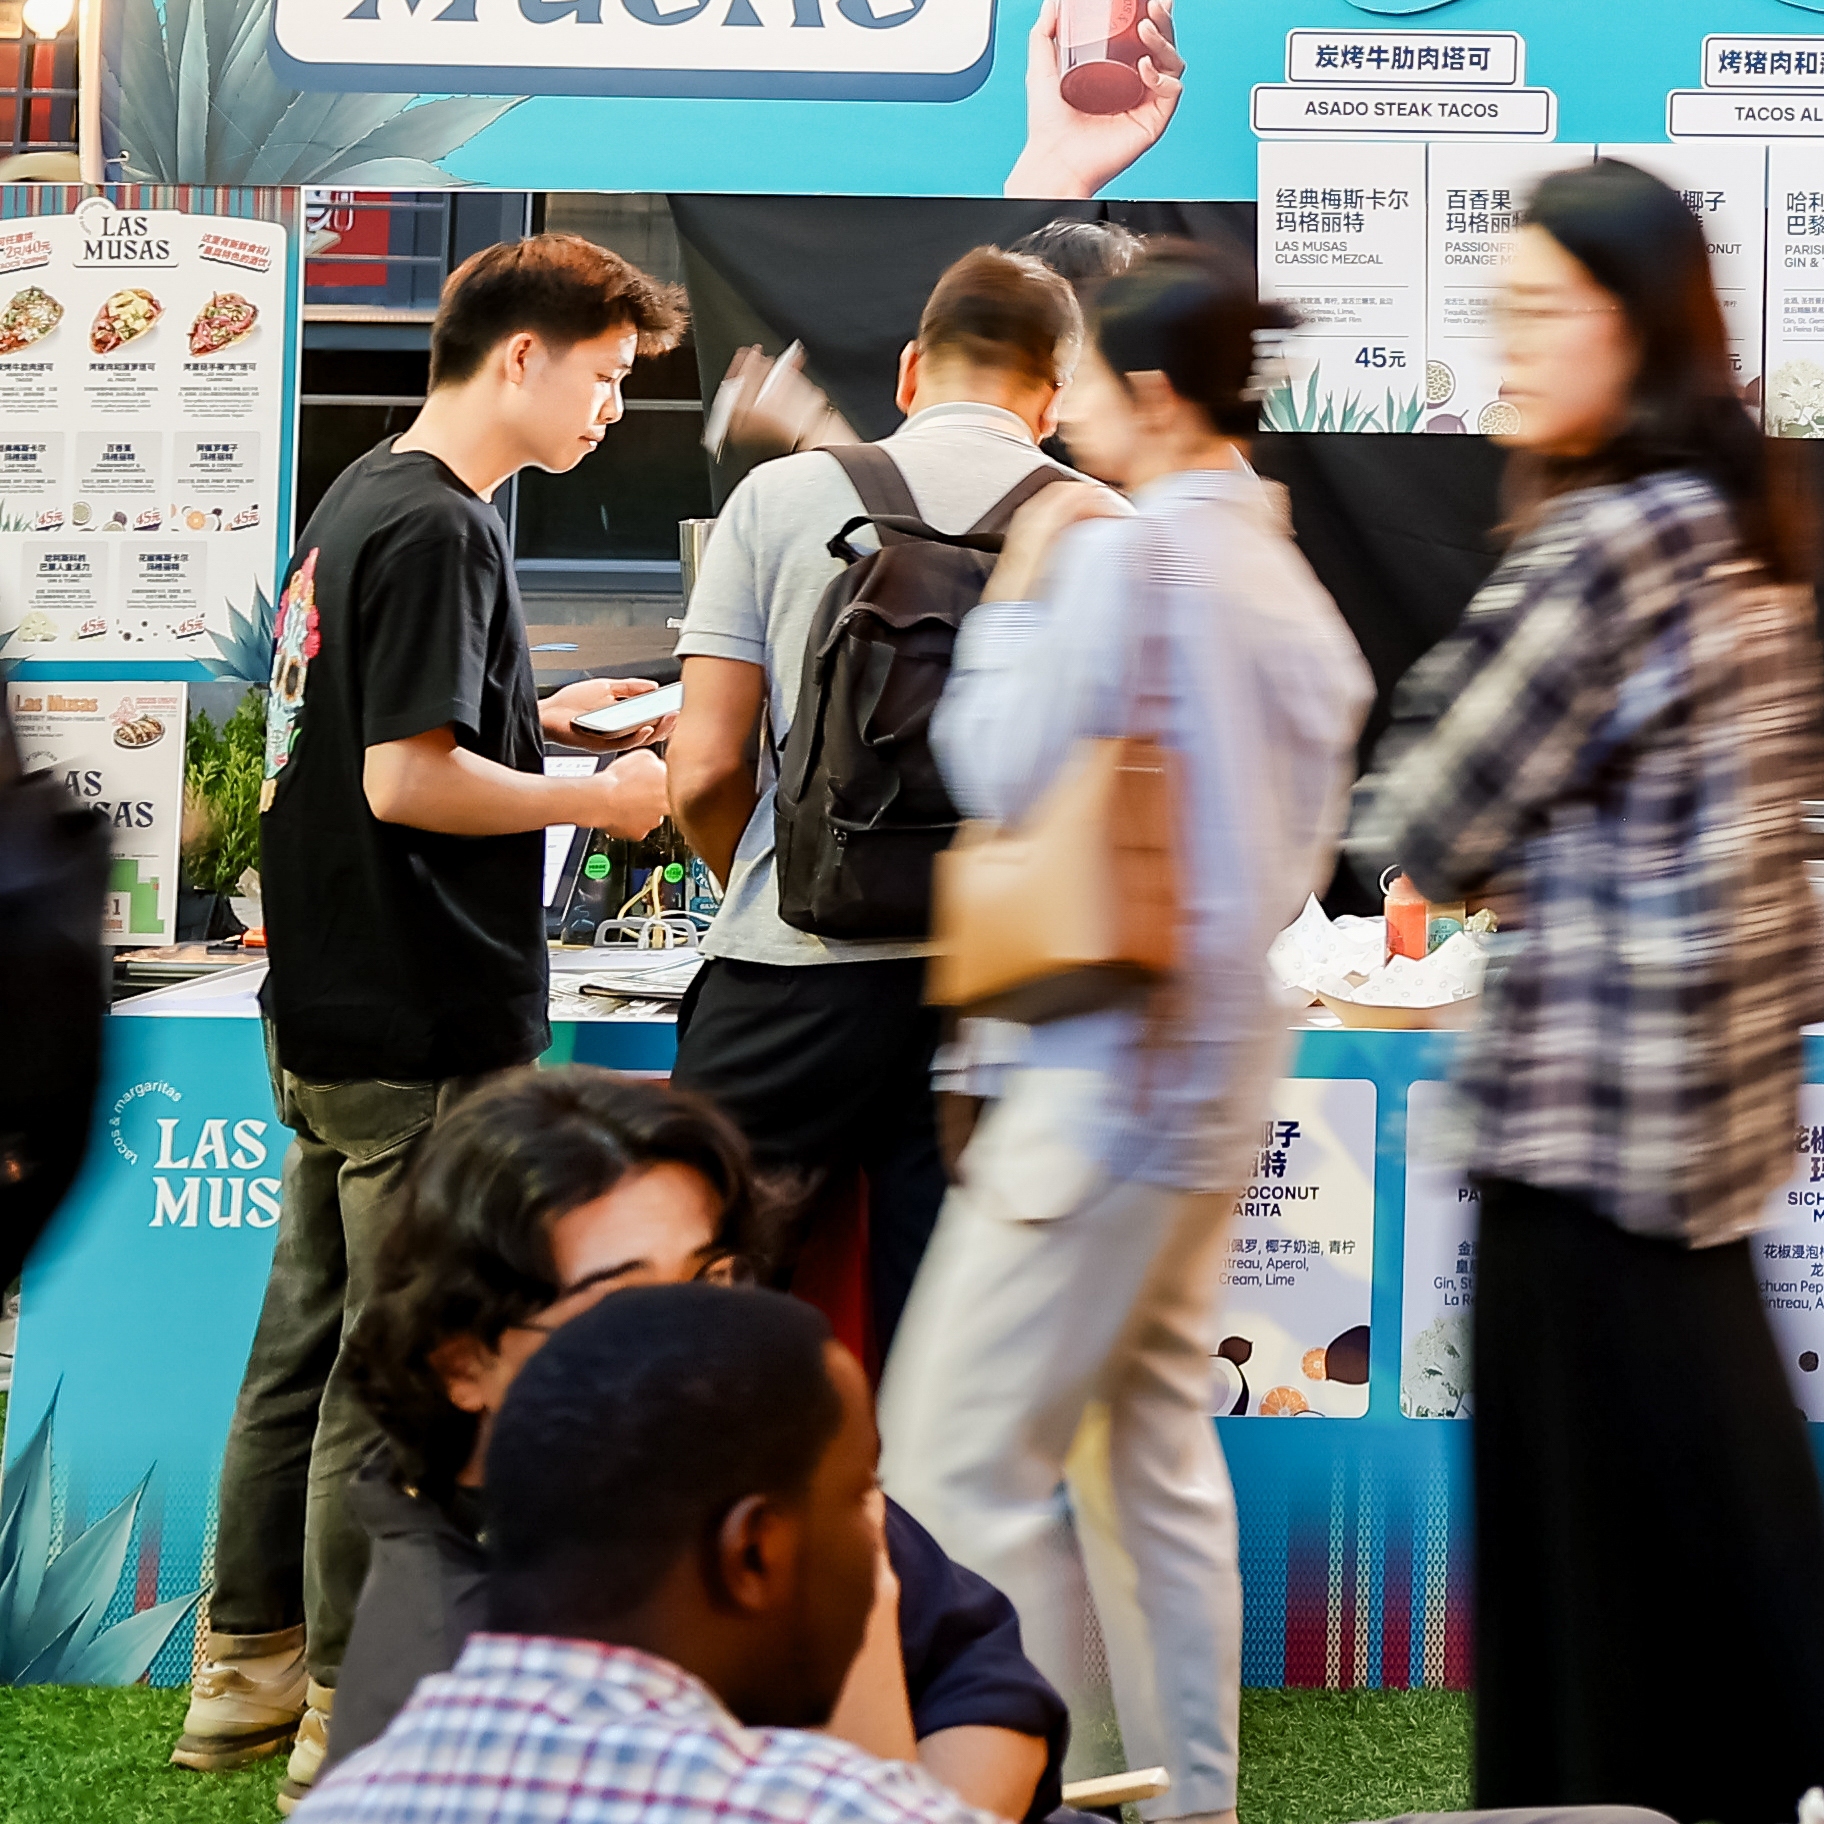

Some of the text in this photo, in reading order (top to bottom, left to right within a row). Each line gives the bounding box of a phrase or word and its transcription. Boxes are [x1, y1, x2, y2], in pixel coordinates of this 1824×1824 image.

[1314, 44, 1491, 72] 炭烤牛肋肉塔可
[1305, 101, 1498, 117] ASADO STEAK TACOS
[1735, 107, 1795, 121] TACOS
[1800, 107, 1823, 121] AL
[1275, 188, 1409, 211] 经典梅斯卡尔
[1446, 189, 1512, 211] 百香果
[101, 216, 148, 237] LAS
[1275, 211, 1365, 234] 玛格丽特
[83, 239, 170, 260] MUSAS
[1275, 241, 1347, 252] LAS MUSAS
[1275, 254, 1383, 264] CLASSIC MEZCAL
[1445, 255, 1497, 265] ORANGE
[1784, 257, 1806, 268] GIN
[1810, 257, 1818, 268] &
[1354, 346, 1407, 369] 45元
[65, 770, 103, 796] AS
[114, 1080, 182, 1114] margaritas
[111, 1128, 138, 1166] tacos
[153, 1118, 268, 1170] LAS
[149, 1177, 282, 1228] MUS
[1232, 1203, 1282, 1217] ARITA
[1328, 1240, 1356, 1255] 青柠
[1266, 1257, 1310, 1272] Aperol,
[1265, 1274, 1296, 1287] Lime
[1433, 1276, 1457, 1291] Gin,
[1444, 1294, 1460, 1306] La
